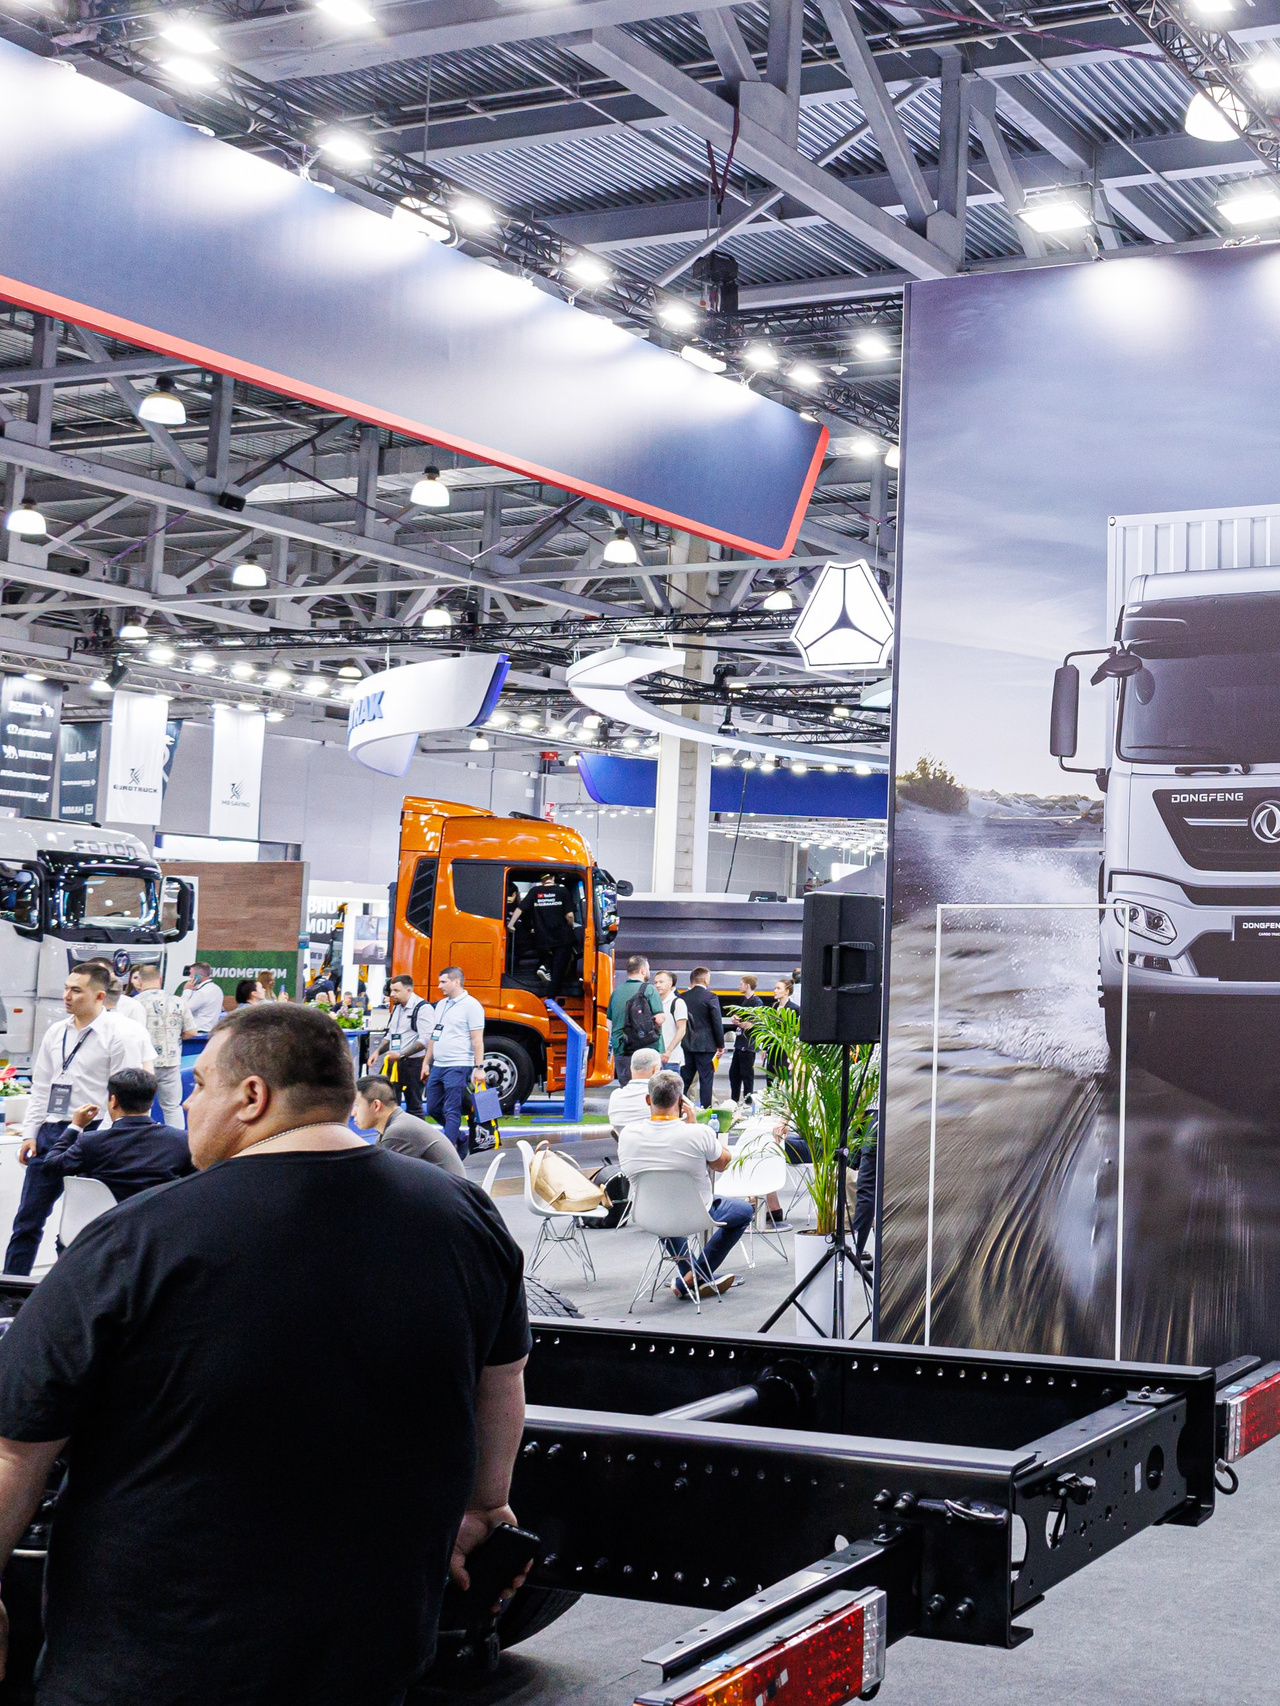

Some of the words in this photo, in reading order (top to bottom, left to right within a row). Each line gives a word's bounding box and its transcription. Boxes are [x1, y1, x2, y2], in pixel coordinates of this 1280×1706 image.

[113, 784, 158, 794] EUROTRUCK
[1171, 793, 1244, 803] DONGFENG
[307, 899, 339, 914] ВНО
[210, 967, 287, 979] илометом
